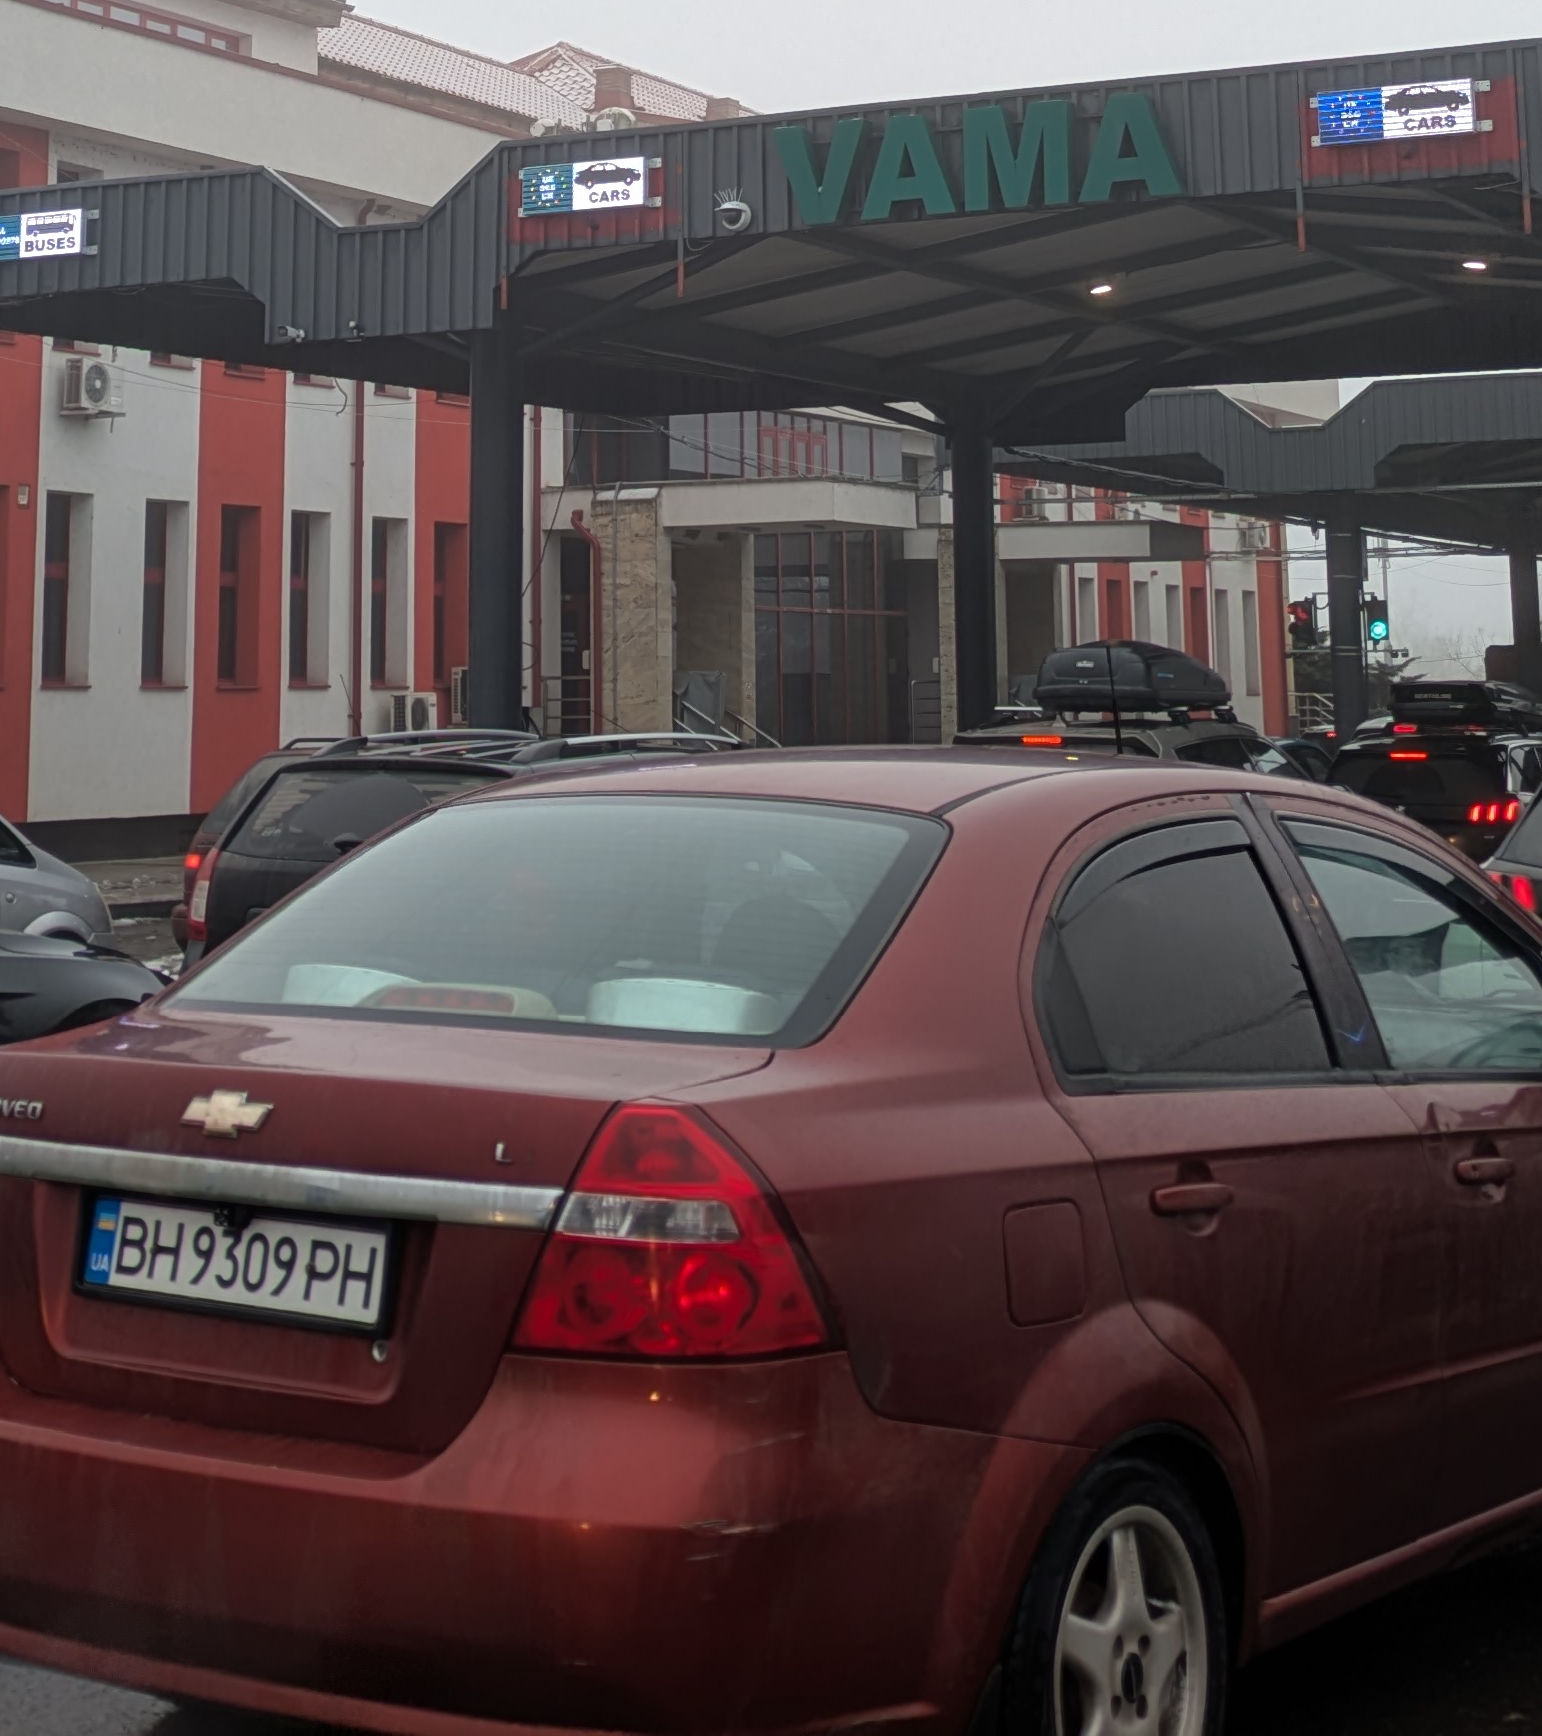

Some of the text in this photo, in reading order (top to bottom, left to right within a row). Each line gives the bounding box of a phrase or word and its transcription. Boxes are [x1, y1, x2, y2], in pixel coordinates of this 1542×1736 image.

[1403, 115, 1457, 131] CARS
[773, 92, 1183, 226] VAMA
[588, 189, 630, 203] CARS
[24, 237, 76, 252] BUSES
[91, 1252, 109, 1272] UA
